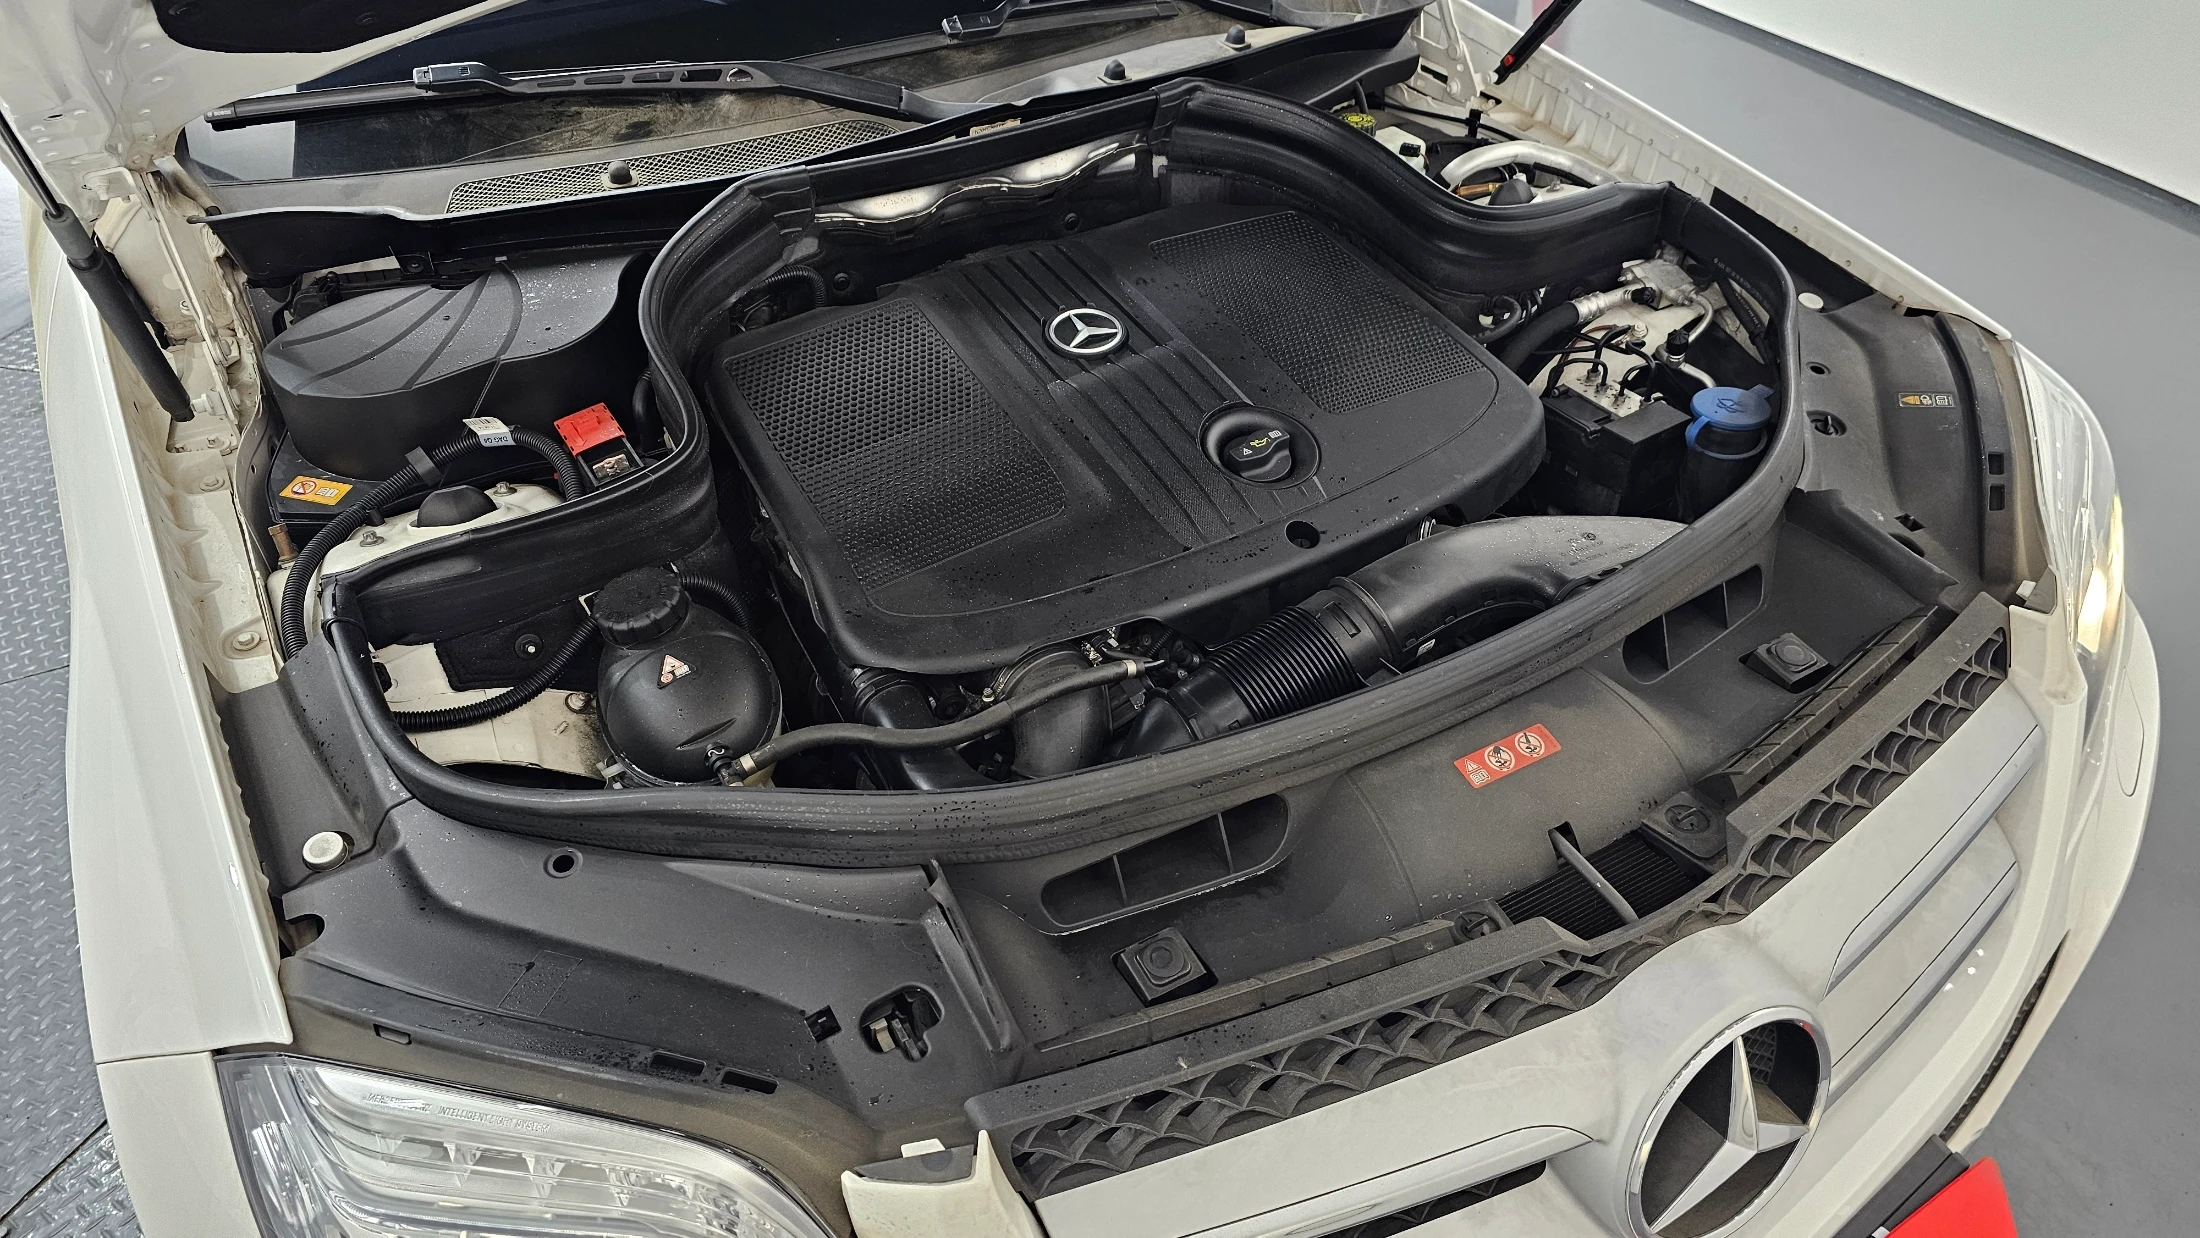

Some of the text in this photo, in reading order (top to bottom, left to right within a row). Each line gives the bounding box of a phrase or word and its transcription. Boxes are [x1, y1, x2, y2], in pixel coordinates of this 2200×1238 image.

[366, 1092, 433, 1112] MERCENZ
[437, 1105, 491, 1123] INTELLIGENT
[514, 1118, 551, 1133] SYSTEM
